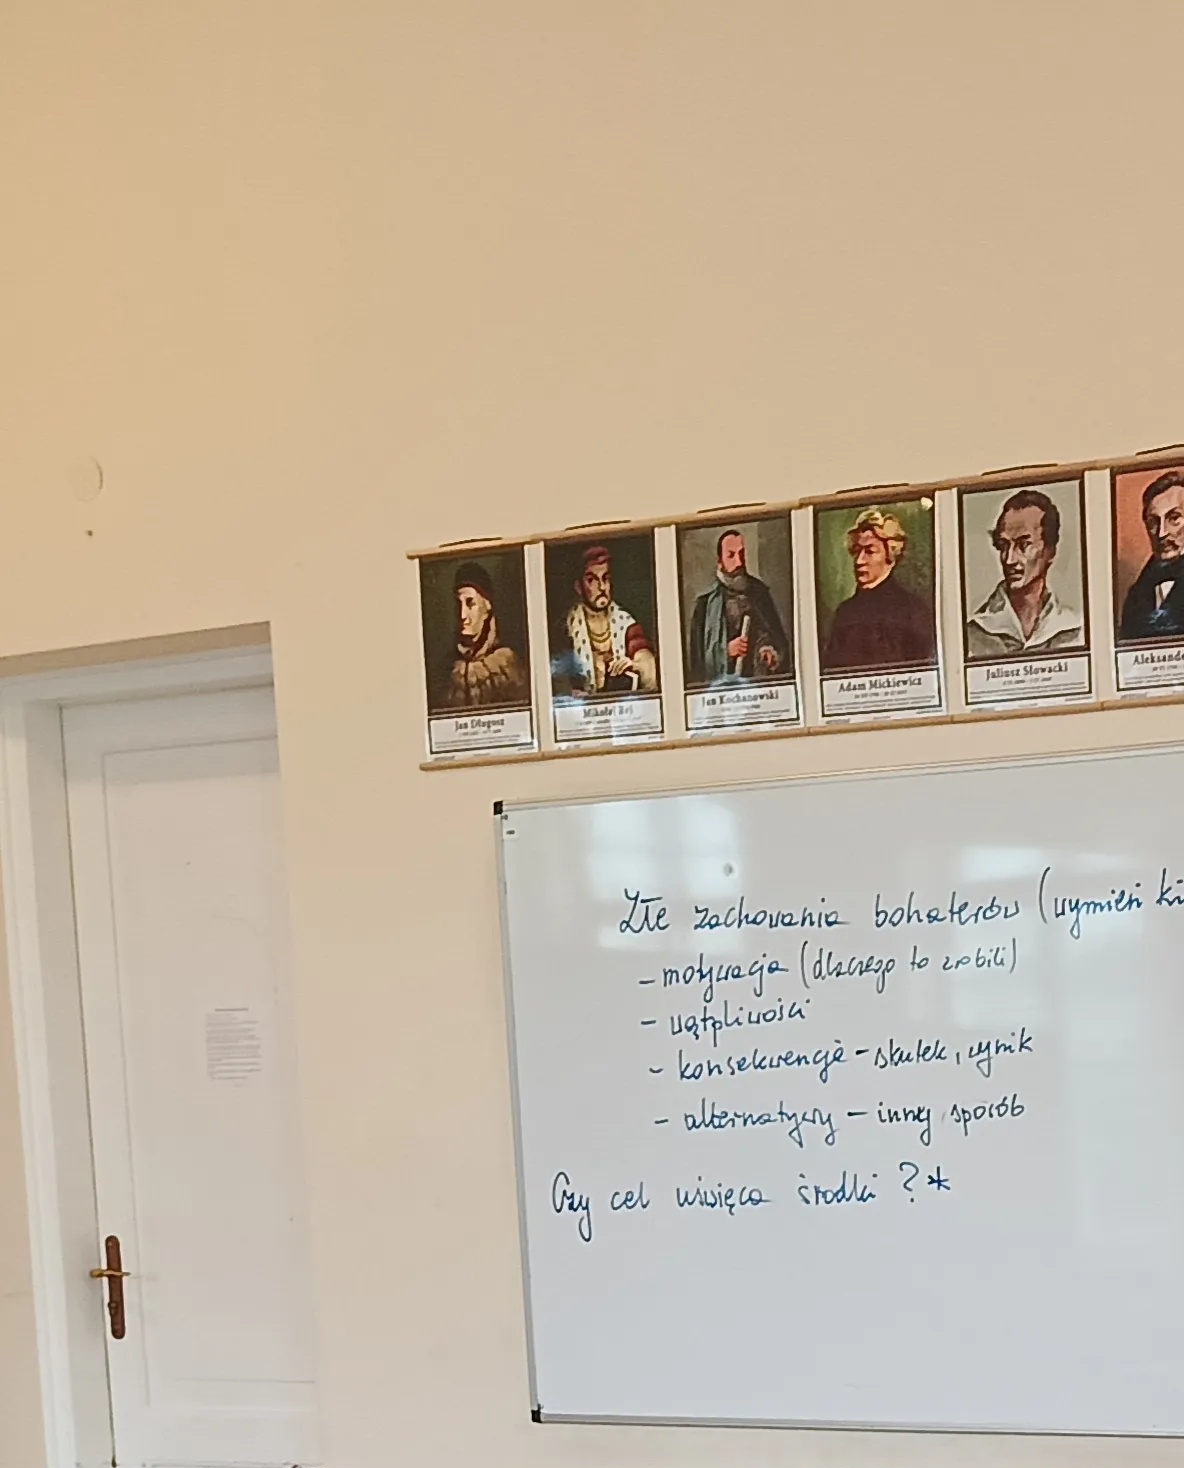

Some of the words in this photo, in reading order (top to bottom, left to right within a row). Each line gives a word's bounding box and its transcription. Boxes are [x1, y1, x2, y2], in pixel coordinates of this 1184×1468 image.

[838, 679, 867, 693] Adam
[869, 676, 923, 691] Mickiewicz
[986, 665, 1021, 682] Juliusz
[1023, 661, 1069, 678] Słowacki
[701, 696, 717, 709] Jan
[718, 689, 780, 707] Kochanowski
[454, 719, 469, 732] Jan
[470, 717, 506, 731] Długosz
[619, 888, 671, 934] Złe
[694, 896, 851, 932] zachowania
[874, 891, 1022, 928] bohaterów
[909, 945, 931, 971] to
[968, 1027, 1034, 1079] wynik
[877, 1104, 932, 1147] inny
[948, 1093, 1026, 1137] sposób
[551, 1171, 593, 1243] Czy
[609, 1181, 651, 1210] cel
